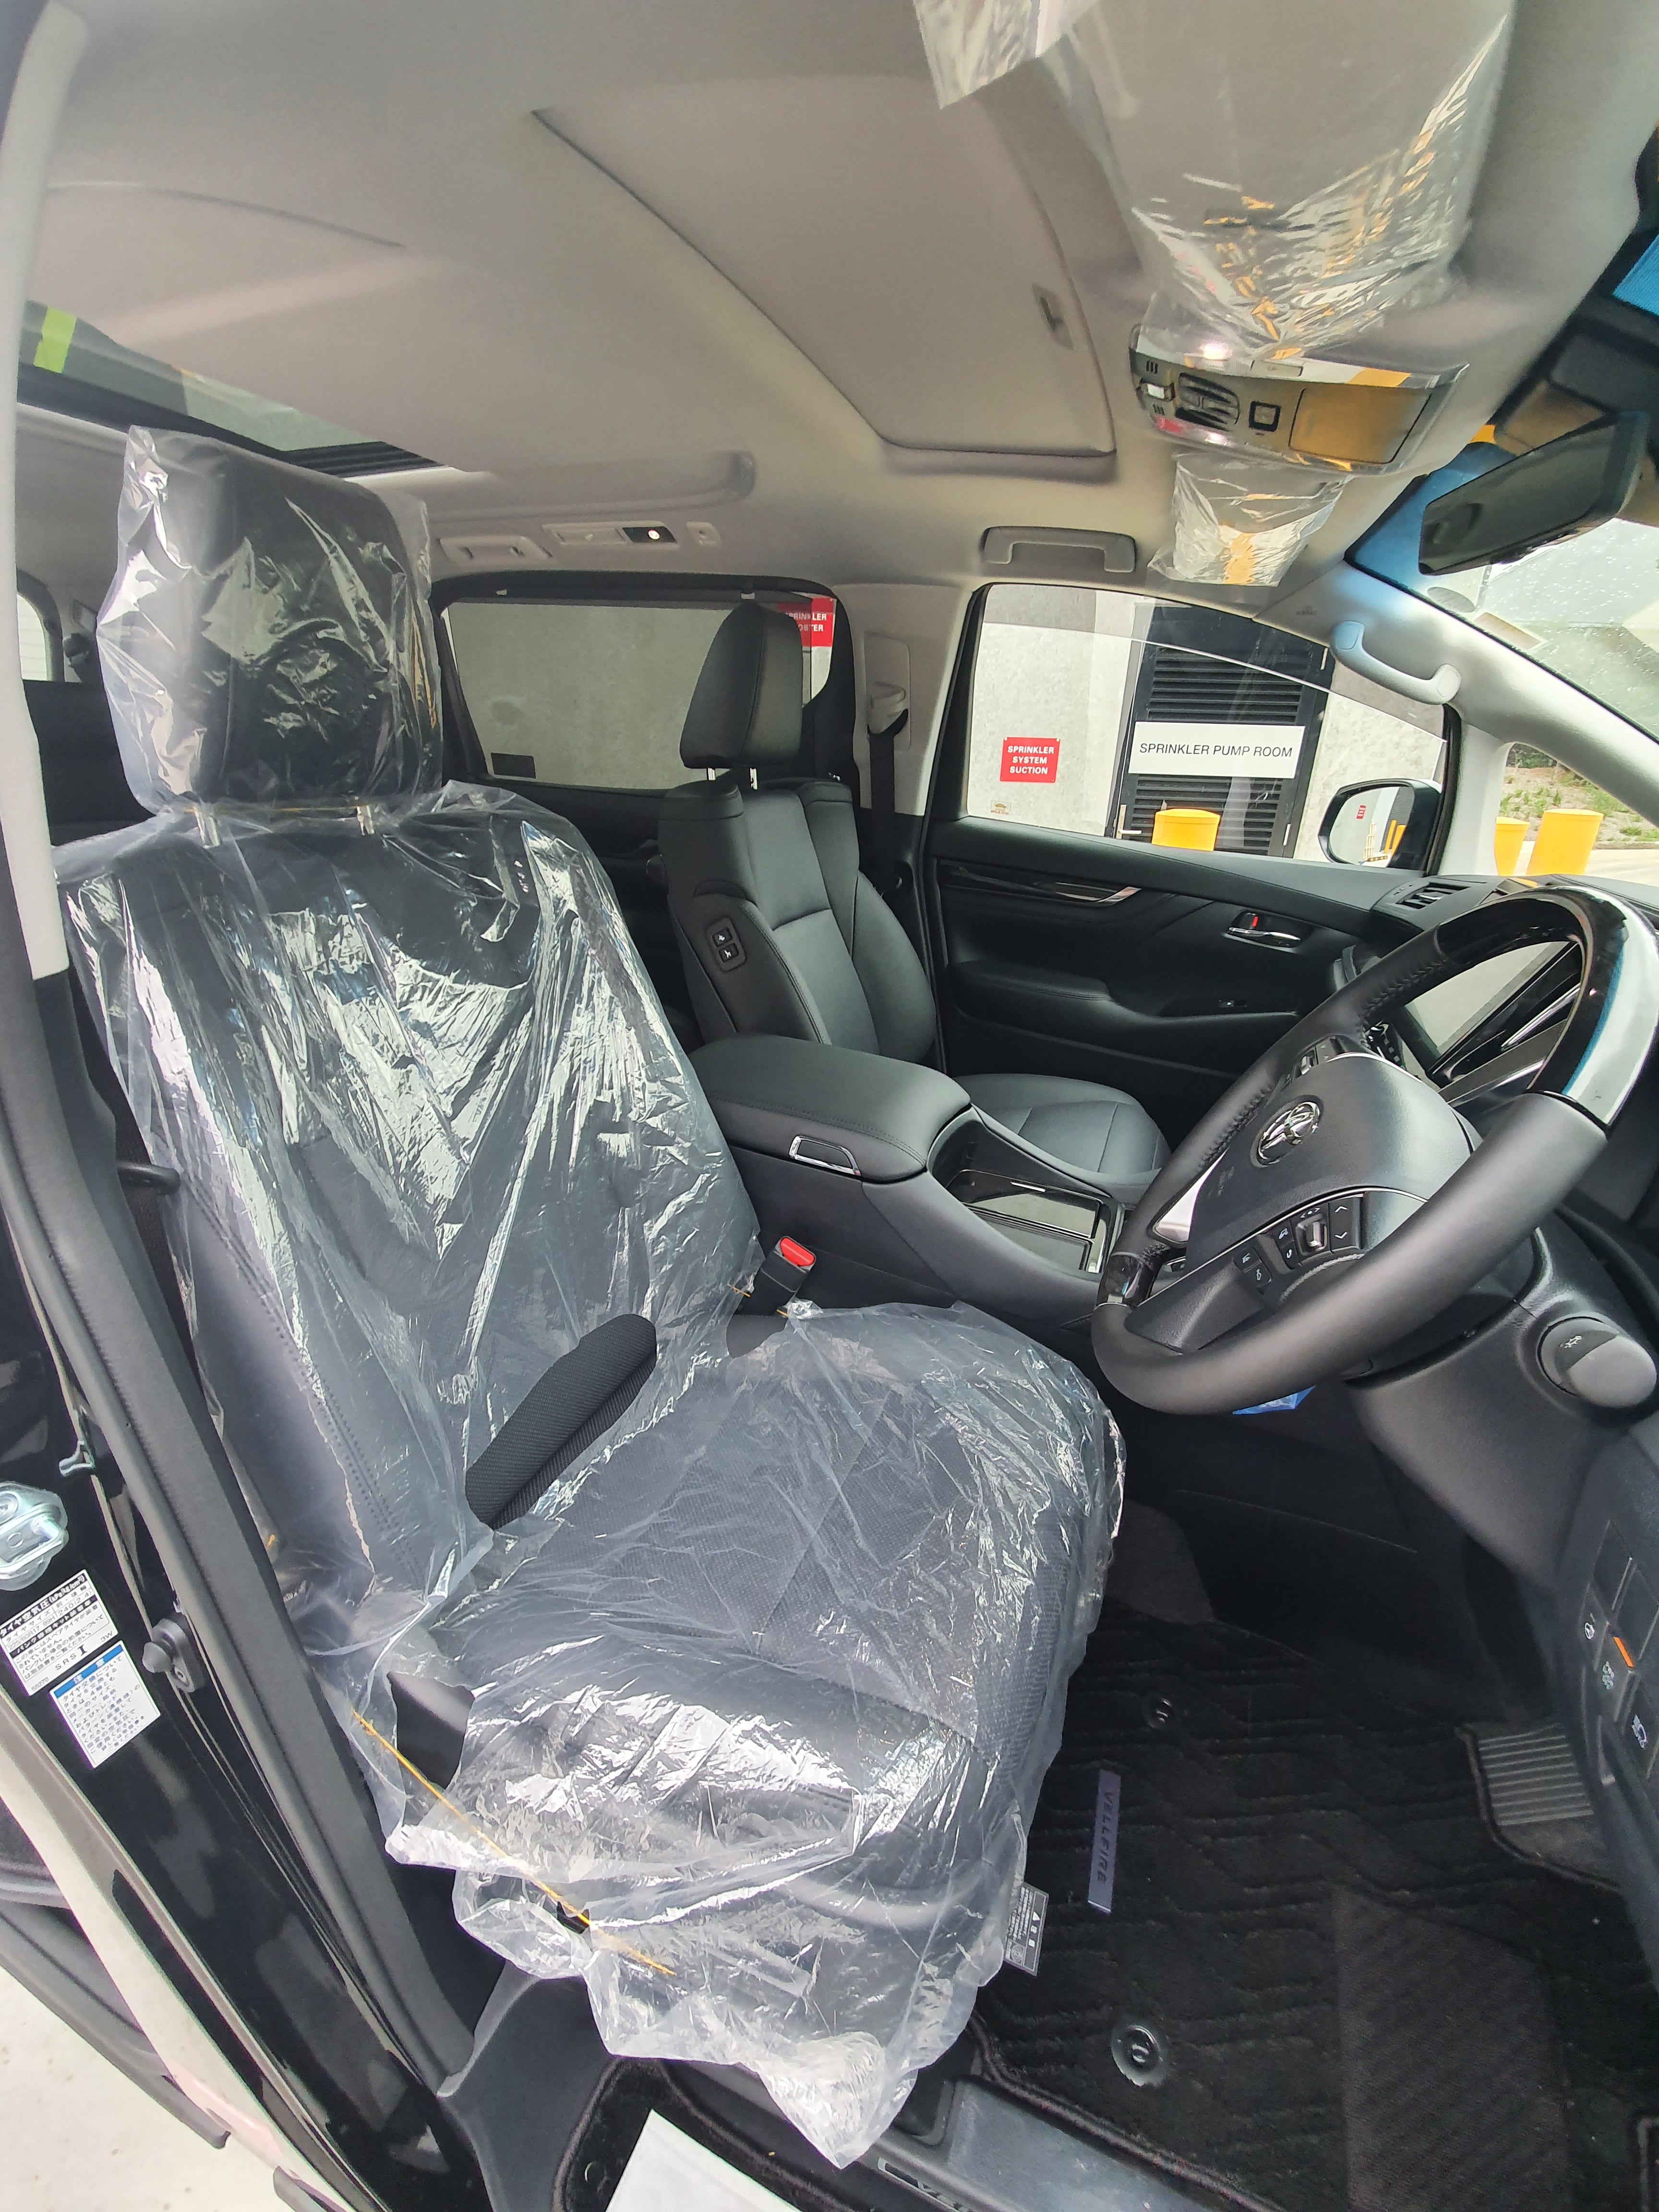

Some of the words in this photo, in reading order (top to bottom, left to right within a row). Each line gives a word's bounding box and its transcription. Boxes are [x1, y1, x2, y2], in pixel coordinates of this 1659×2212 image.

[1008, 745, 1055, 754] SPRINKLER
[1140, 743, 1209, 755] SPRINKLER
[1213, 745, 1250, 756] PUMP
[1253, 746, 1293, 757] ROOM
[1012, 756, 1047, 764] SYSTEM
[1010, 766, 1048, 774] SUCTION
[1097, 1792, 1113, 1883] VELLFIRE
